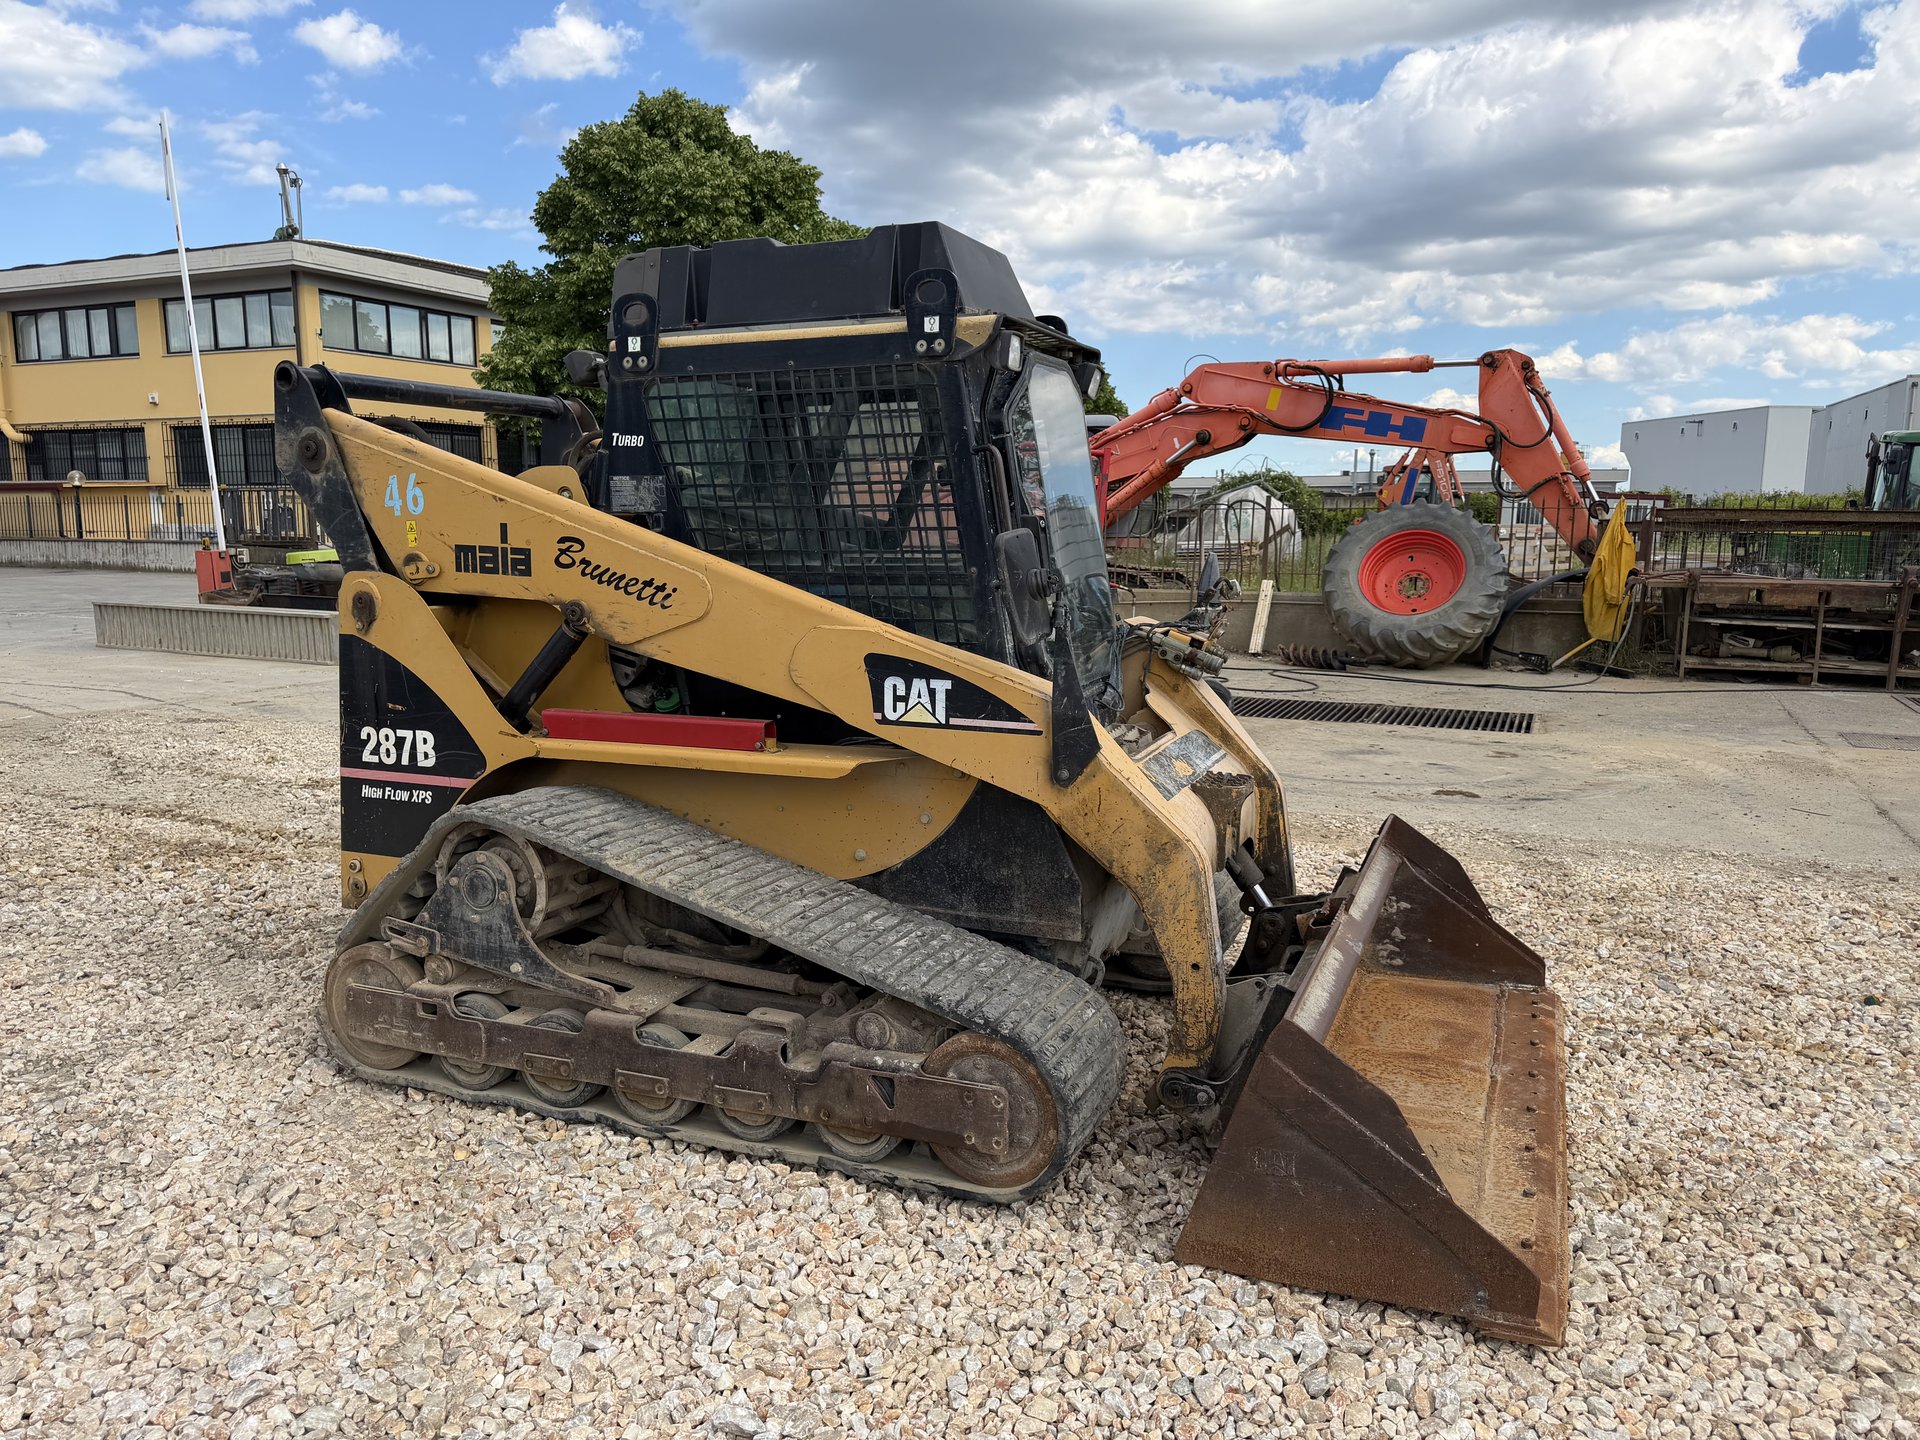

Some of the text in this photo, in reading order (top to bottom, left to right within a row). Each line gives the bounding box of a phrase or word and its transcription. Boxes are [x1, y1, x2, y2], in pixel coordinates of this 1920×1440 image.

[1319, 406, 1428, 443] FH
[384, 472, 425, 516] 46
[554, 536, 678, 610] Brunetti
[883, 675, 952, 725] CAT
[360, 725, 436, 768] 287B
[411, 789, 433, 804] XPS
